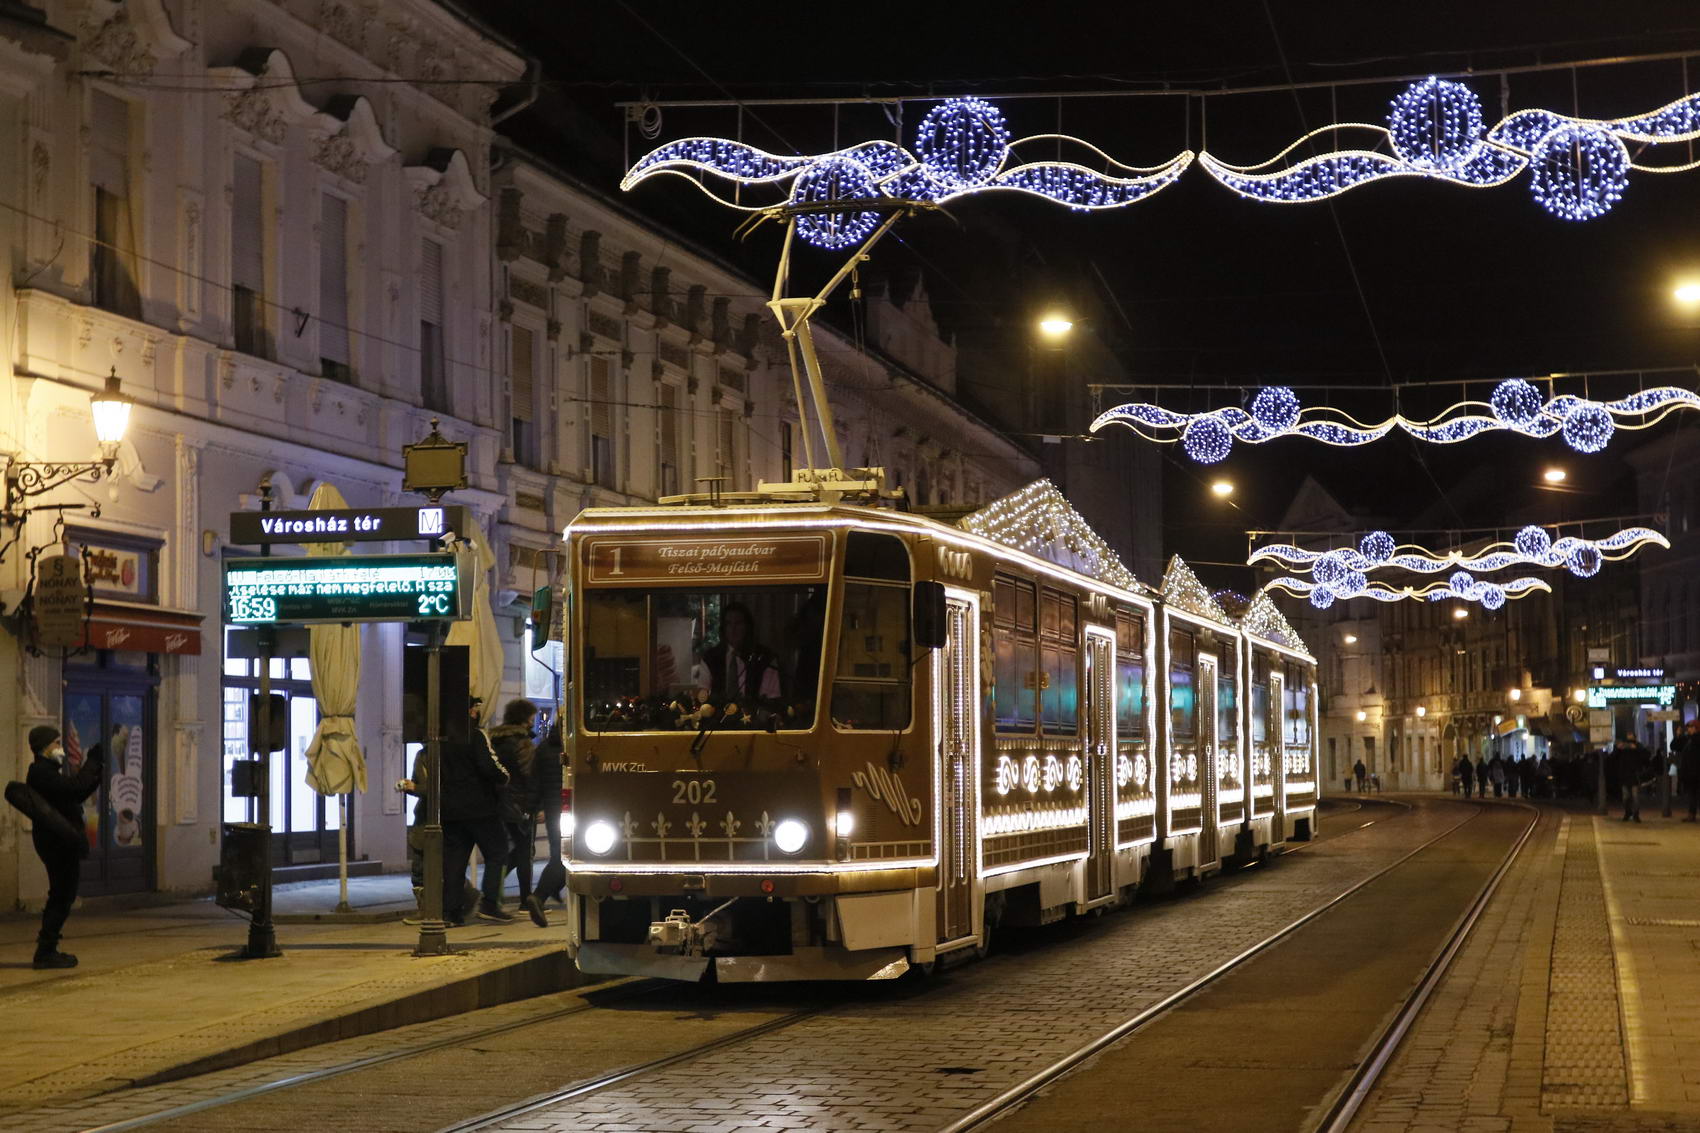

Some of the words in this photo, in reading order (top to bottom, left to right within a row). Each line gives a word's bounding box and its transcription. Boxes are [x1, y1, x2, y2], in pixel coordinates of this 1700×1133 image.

[261, 517, 347, 533] Városház
[353, 516, 380, 531] tér
[658, 545, 699, 558] Tiszai
[700, 543, 776, 560] pályaudvar
[608, 547, 625, 575] 1
[668, 560, 759, 576] Felső-Majláth
[288, 581, 314, 595] már
[316, 582, 341, 595] nem
[416, 580, 425, 592] A
[229, 597, 276, 618] 16:59
[418, 593, 449, 613] 2°C
[602, 762, 628, 773] MVK
[671, 779, 717, 805] 202
